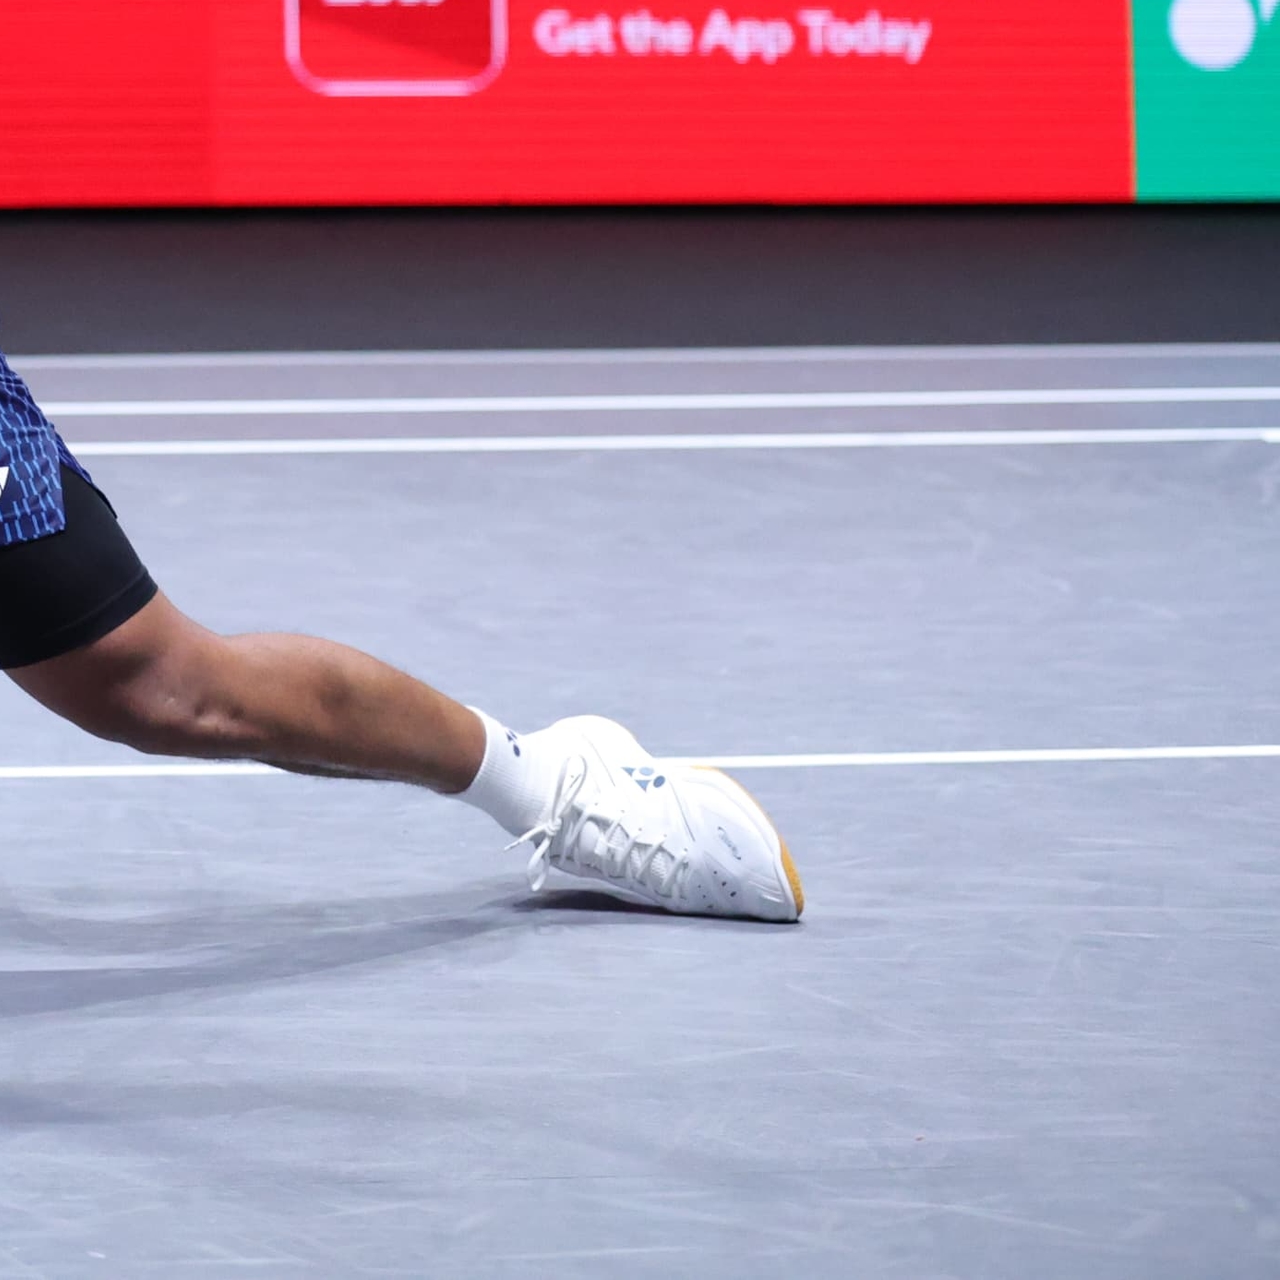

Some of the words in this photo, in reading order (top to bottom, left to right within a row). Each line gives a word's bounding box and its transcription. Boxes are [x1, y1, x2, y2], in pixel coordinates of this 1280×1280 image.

[535, 11, 613, 57] Get
[620, 11, 694, 57] the
[700, 10, 791, 64] App
[797, 10, 930, 64] Today
